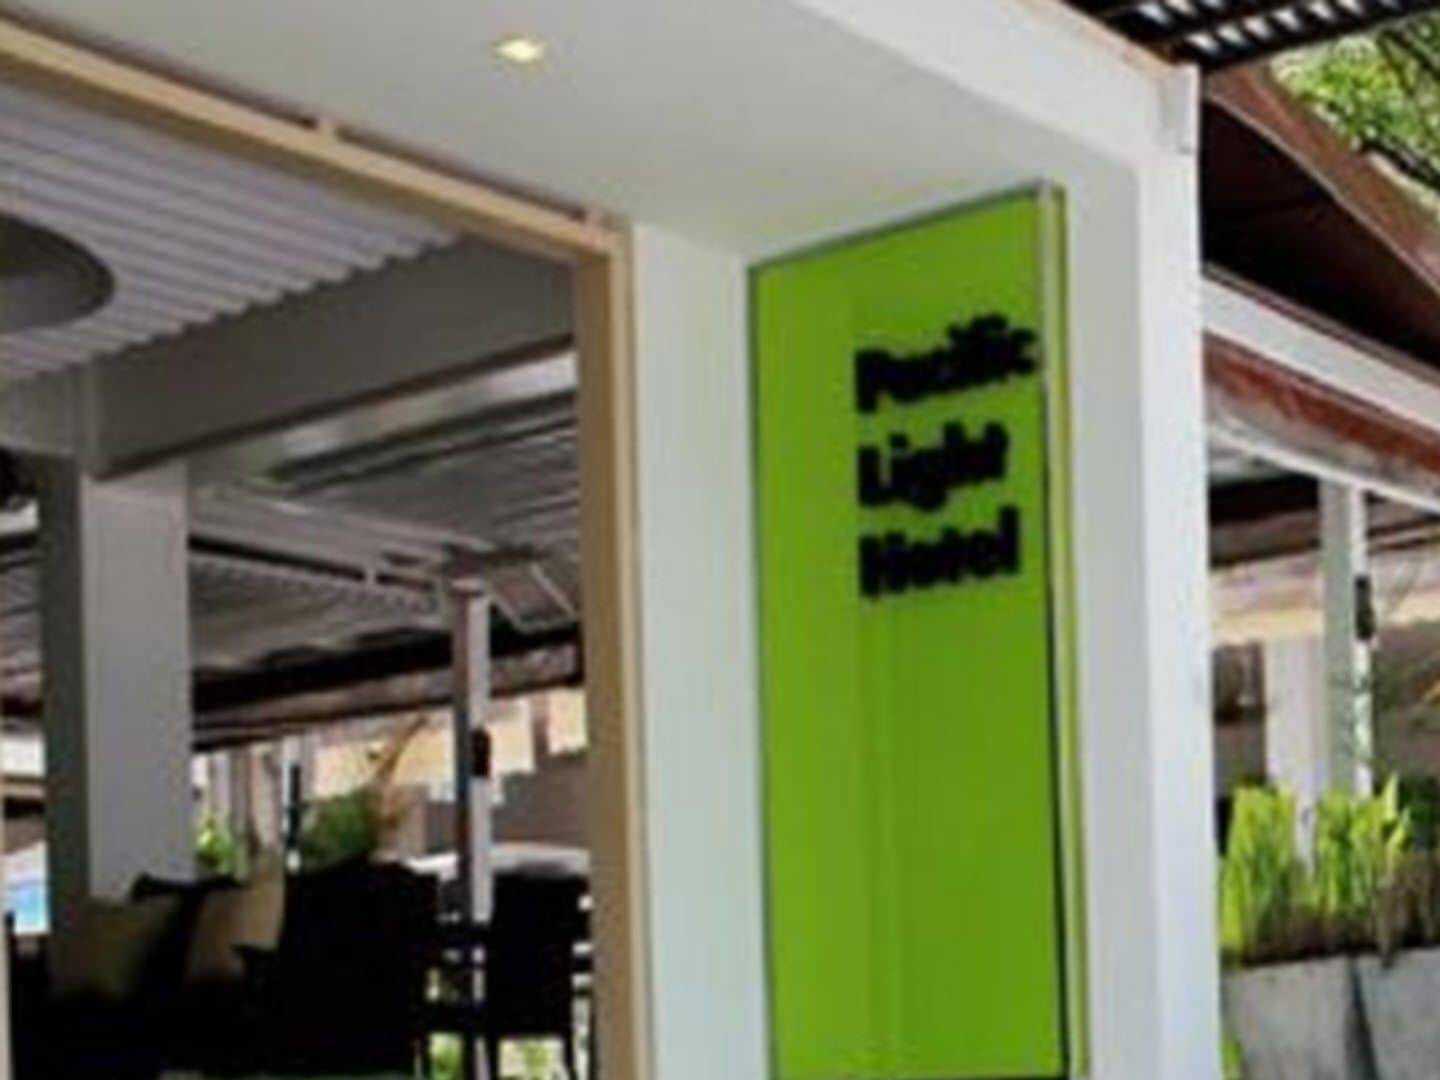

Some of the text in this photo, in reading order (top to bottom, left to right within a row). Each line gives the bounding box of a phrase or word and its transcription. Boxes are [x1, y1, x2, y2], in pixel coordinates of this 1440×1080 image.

[854, 314, 1037, 414] Pacific
[857, 421, 1009, 512] Light
[858, 506, 1020, 600] Hotel
